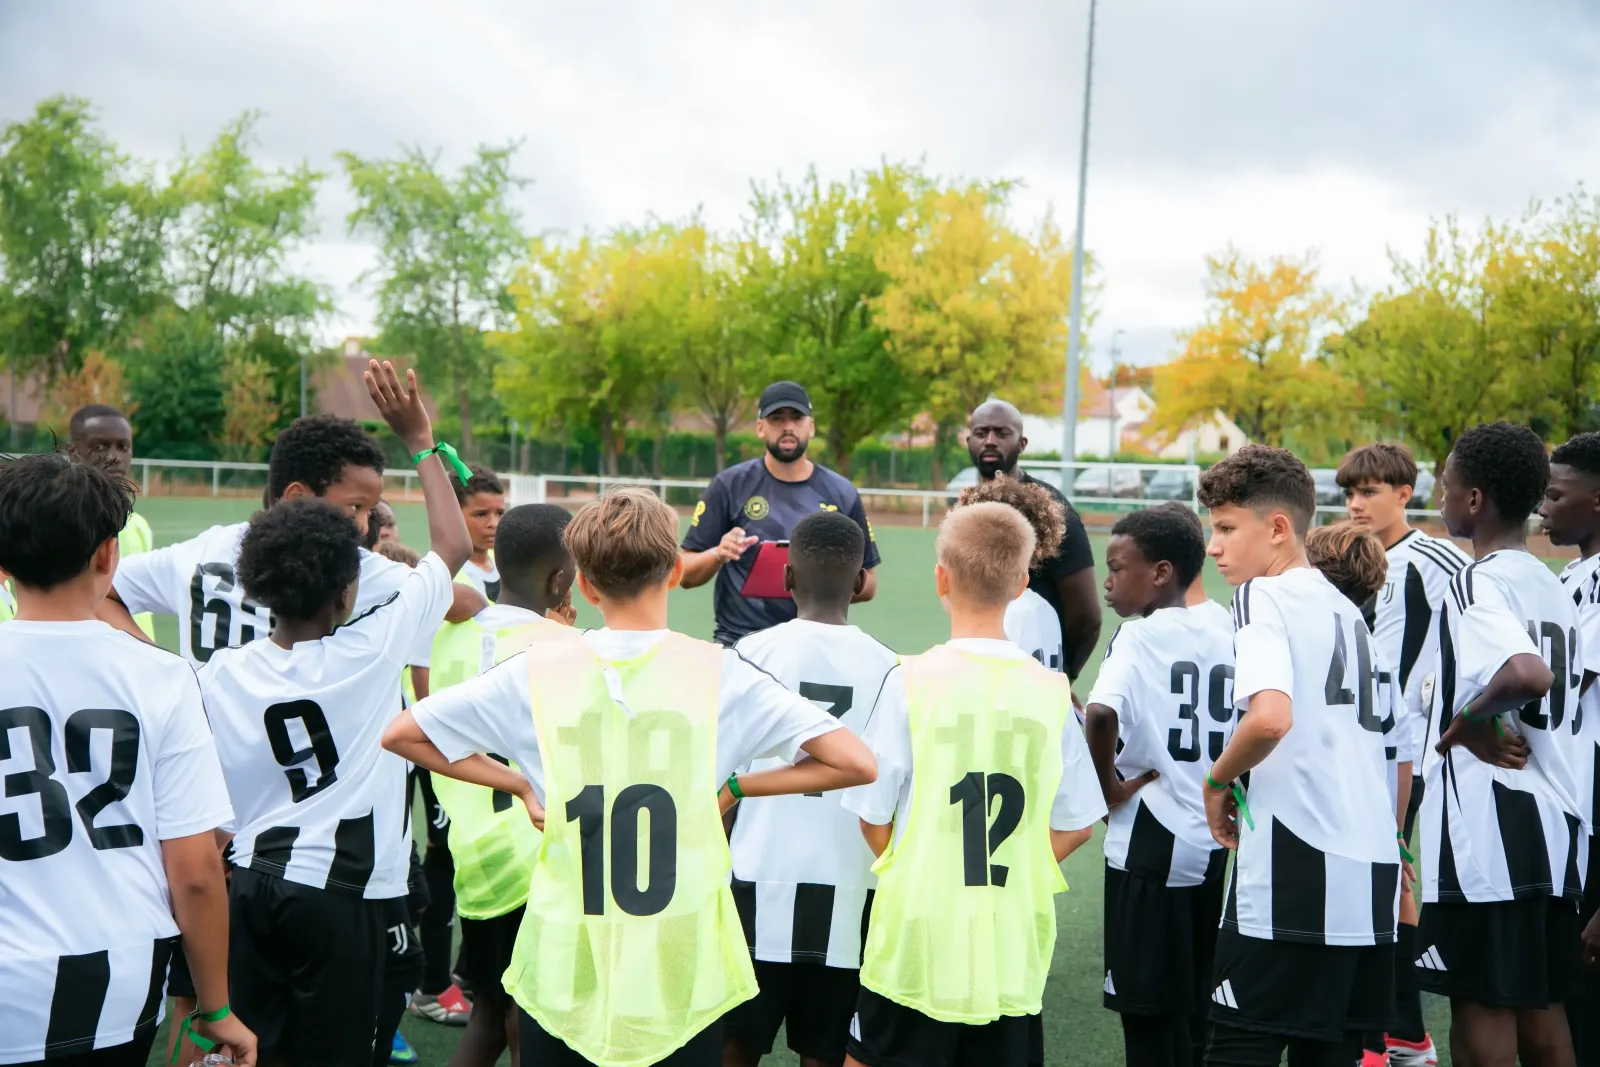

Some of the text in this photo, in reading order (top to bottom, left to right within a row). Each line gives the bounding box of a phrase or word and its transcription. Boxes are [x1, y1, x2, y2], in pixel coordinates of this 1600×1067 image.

[0, 705, 143, 861] 32
[264, 699, 340, 803] 9
[565, 783, 677, 916] 10
[950, 772, 1025, 887] 12
